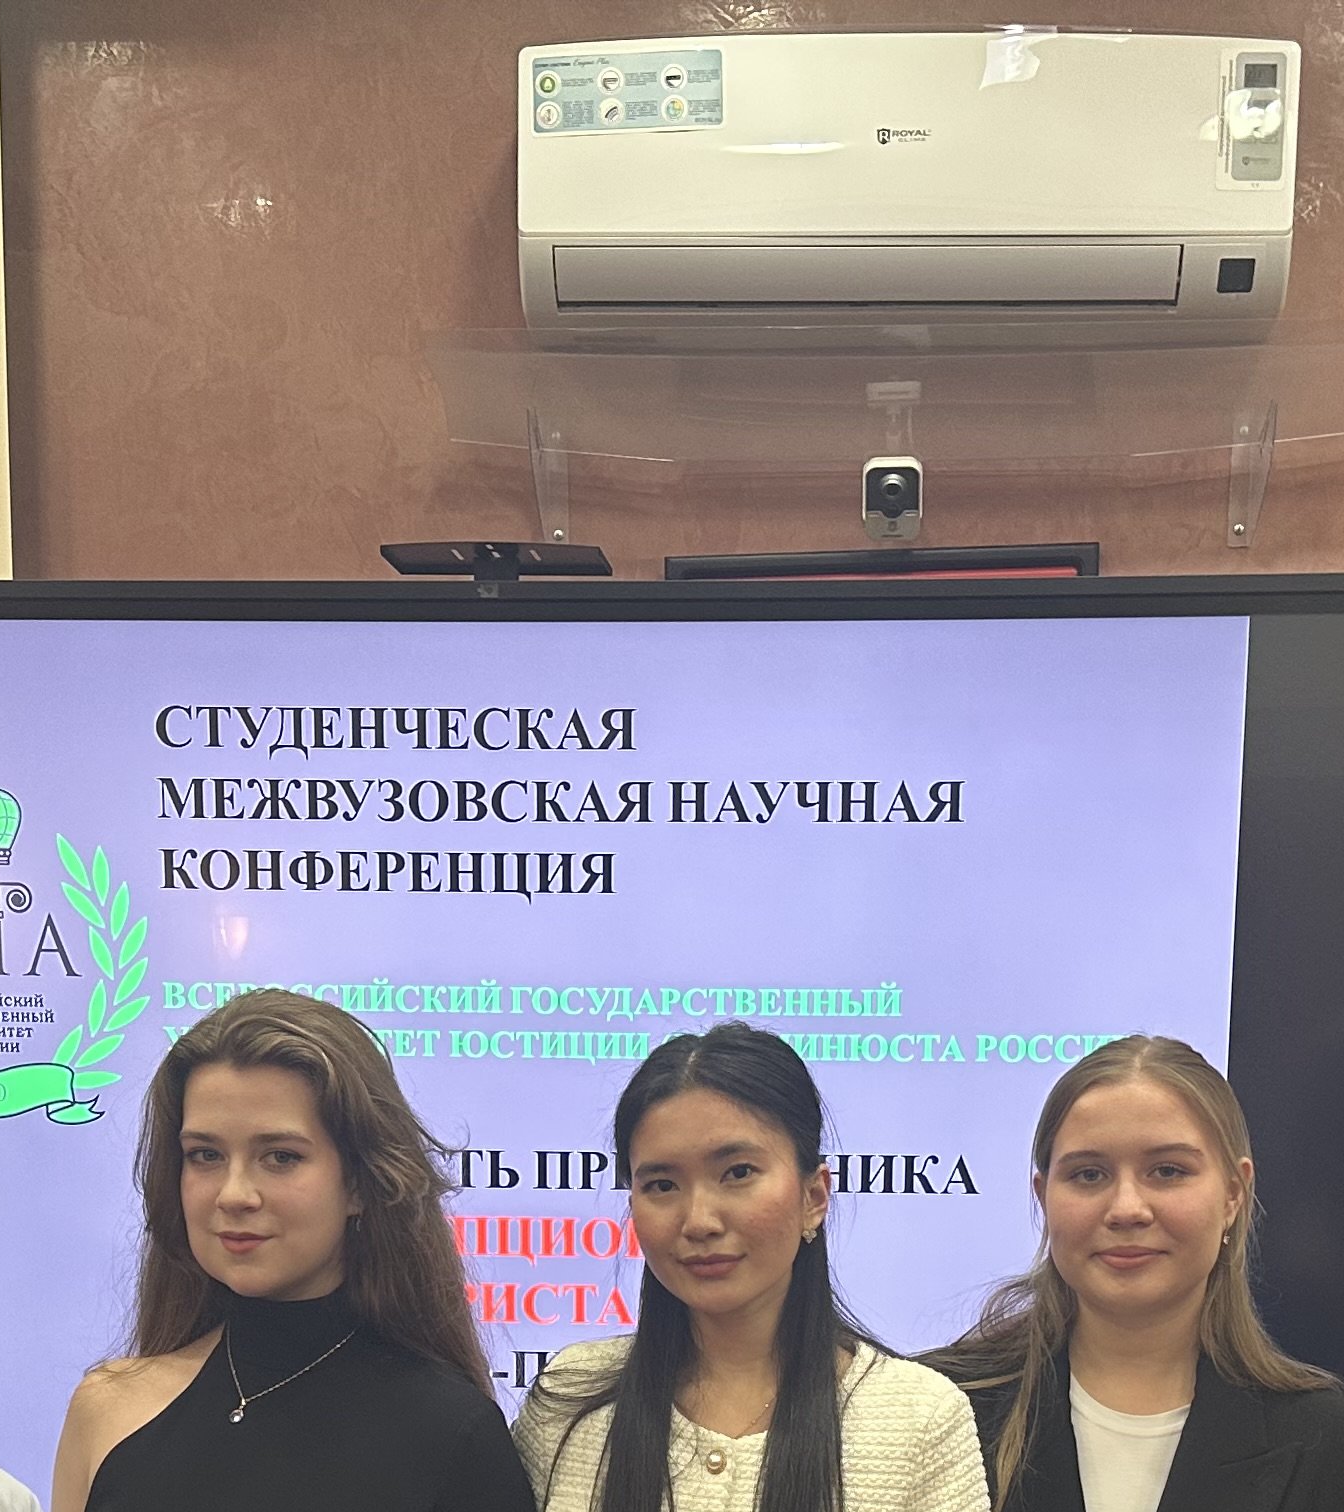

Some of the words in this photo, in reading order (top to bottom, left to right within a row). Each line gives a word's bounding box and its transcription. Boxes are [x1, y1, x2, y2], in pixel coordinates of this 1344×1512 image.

[155, 704, 638, 761] СТУДЕНЧЕСКАЯ
[157, 777, 654, 823] МЕЖВУЗОВСКАЯ
[667, 780, 966, 824] НАУЧНАЯ
[159, 848, 617, 905] КОНФЕРЕНЦИЯ
[163, 978, 503, 1014] ВСЕСИЙСКИЙ
[510, 982, 903, 1023] ГОСУДАРСТВЕННЫЙ
[449, 1030, 651, 1066] ЮСТИЦИИ
[780, 1033, 966, 1064] ИНЮСТА
